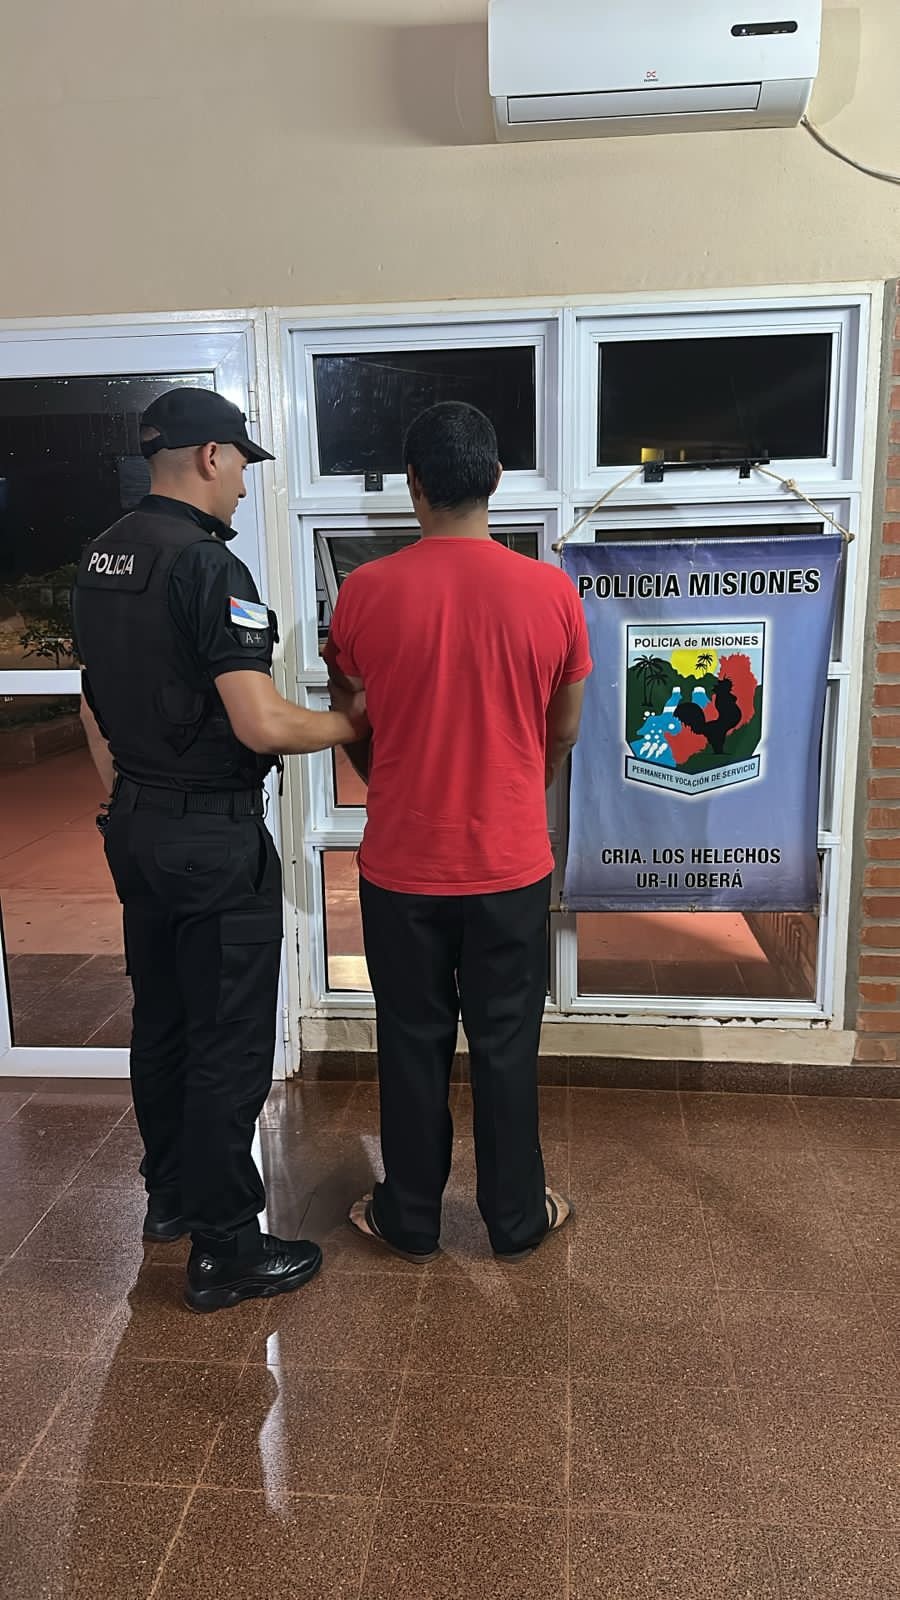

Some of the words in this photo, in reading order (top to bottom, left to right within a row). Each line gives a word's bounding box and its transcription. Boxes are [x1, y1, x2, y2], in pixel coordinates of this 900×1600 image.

[87, 552, 134, 575] POLICIA
[578, 574, 680, 598] POLICIA
[689, 569, 820, 596] MISIONES
[246, 631, 262, 644] A+
[634, 638, 681, 648] POLICIA
[684, 637, 698, 647] de
[701, 636, 759, 646] MISIONES
[632, 765, 674, 783] PERMANENTE
[711, 773, 721, 782] DE
[722, 763, 756, 779] SERVICIO
[601, 848, 647, 864] CRIA.
[652, 848, 685, 864] LOS
[691, 847, 781, 864] HELECHOS
[636, 872, 678, 888] UR-II
[684, 868, 743, 888] OBERÁ
